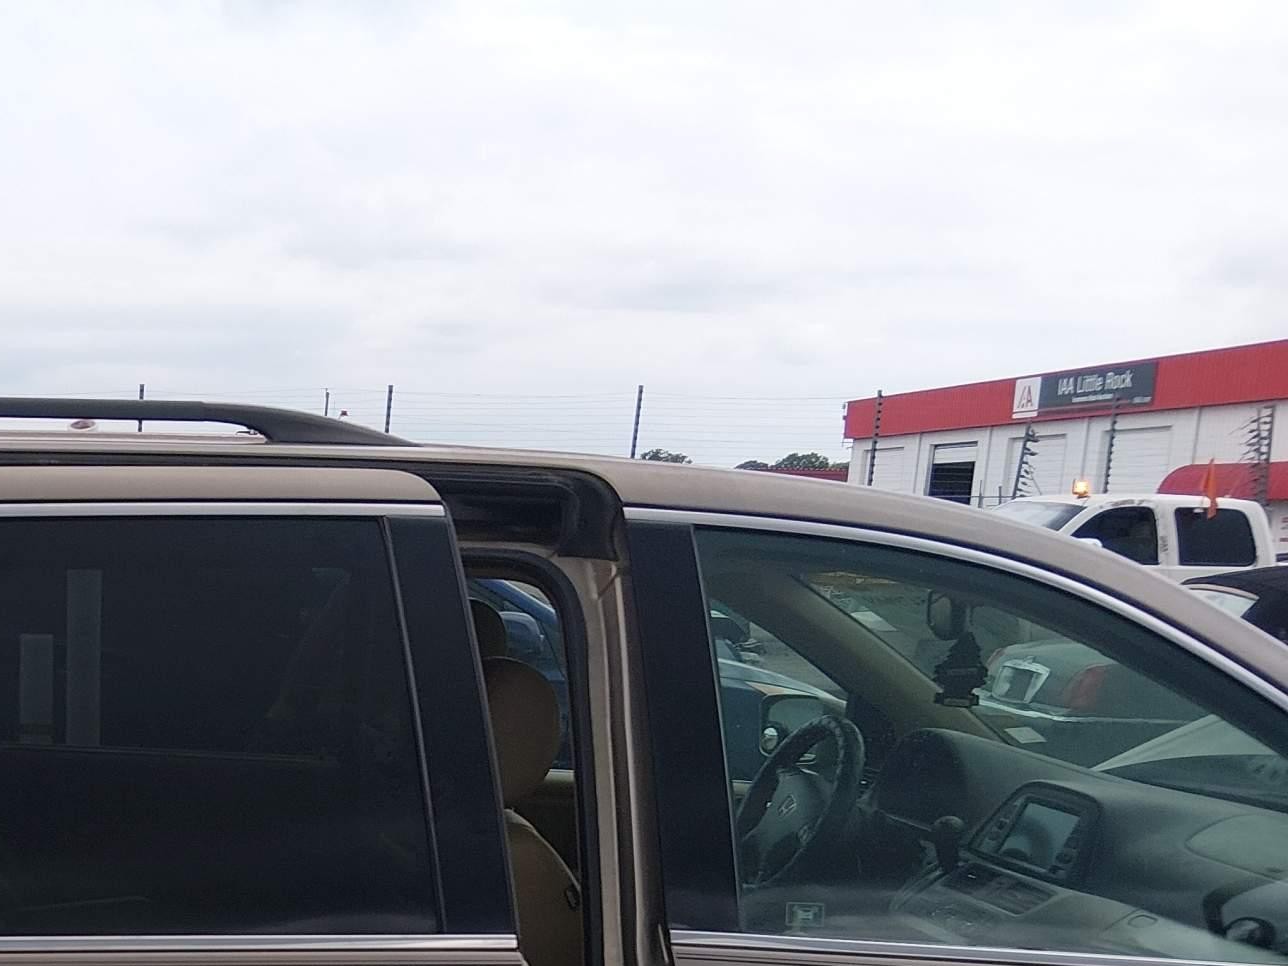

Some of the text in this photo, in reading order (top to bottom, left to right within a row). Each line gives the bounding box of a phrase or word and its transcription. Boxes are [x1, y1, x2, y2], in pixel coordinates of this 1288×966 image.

[1057, 370, 1134, 395] IAA Little Rock
